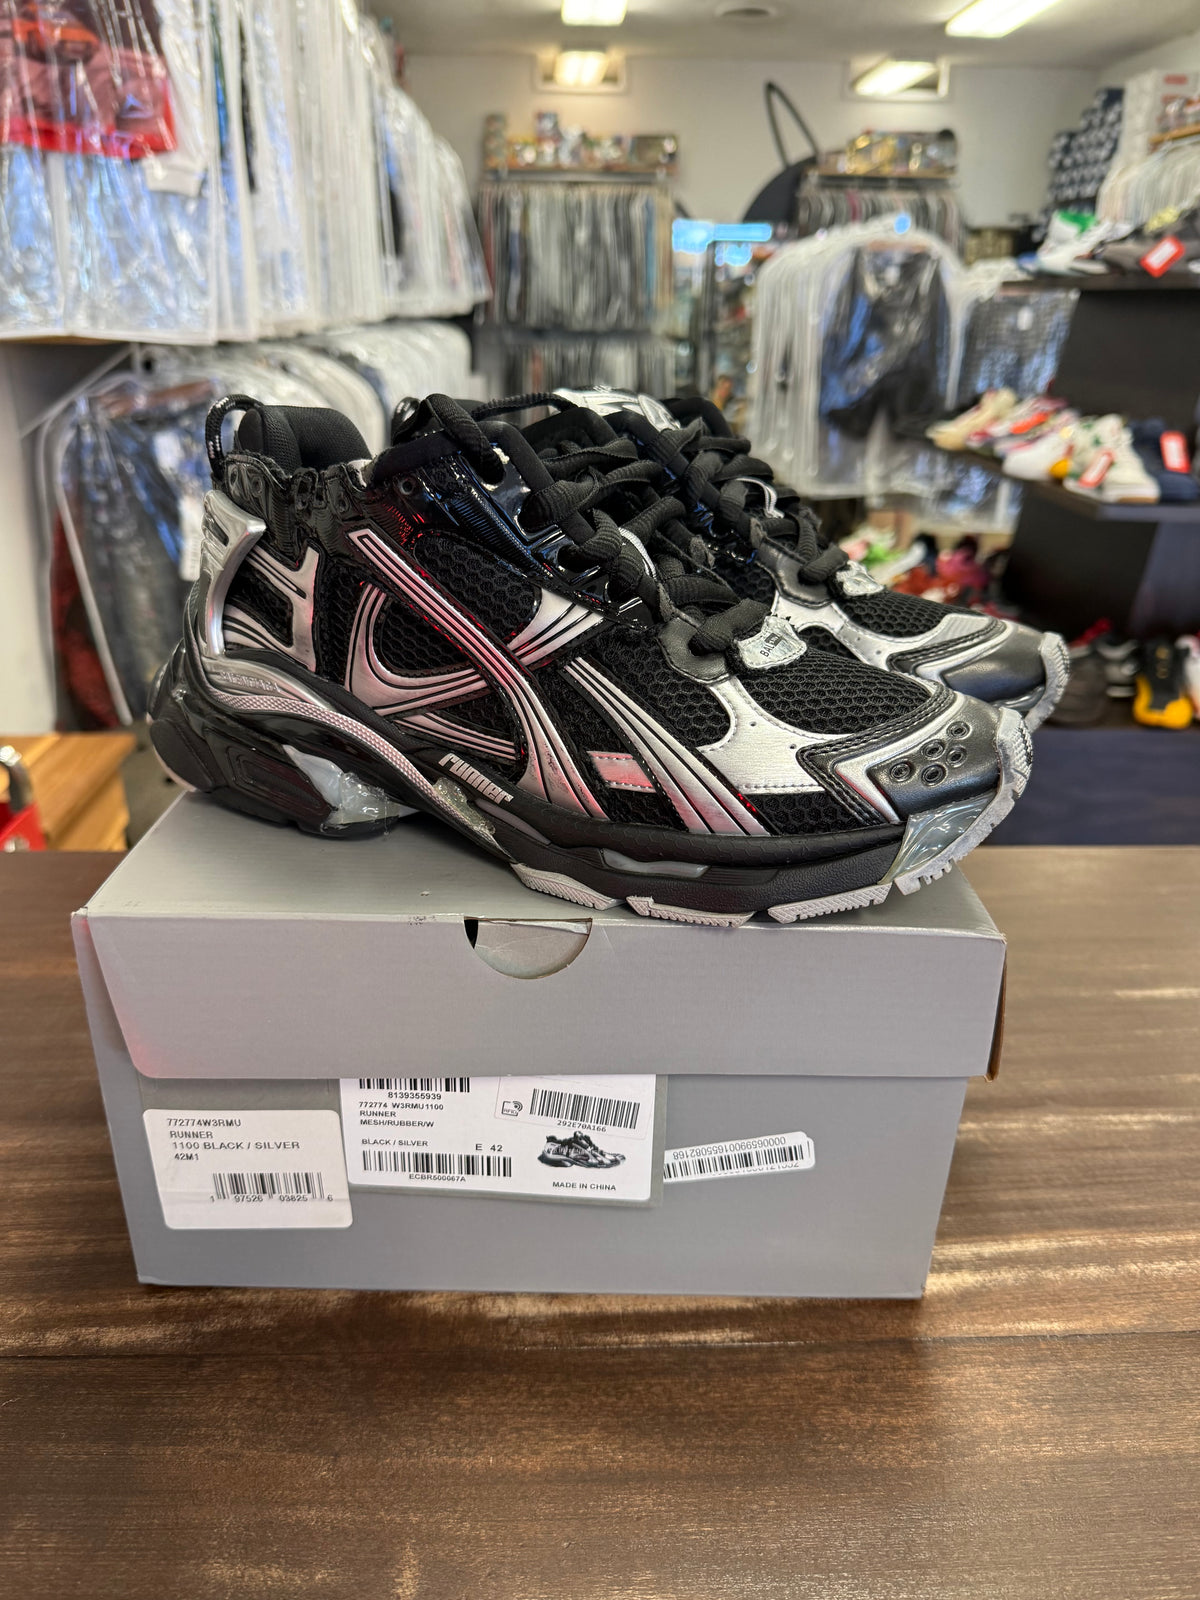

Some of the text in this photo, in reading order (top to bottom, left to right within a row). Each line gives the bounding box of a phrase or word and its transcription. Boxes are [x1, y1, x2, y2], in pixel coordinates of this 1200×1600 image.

[388, 1092, 441, 1100] 8139355939
[392, 1102, 443, 1110] W3RMU1100
[167, 1118, 241, 1127] 772774W3RMU
[360, 1119, 434, 1127] MESH/RUBBER/W
[170, 1131, 213, 1139] RUNNER
[173, 1142, 199, 1150] 1100
[203, 1141, 244, 1149] BLACK
[255, 1141, 300, 1149] SILVER
[361, 1138, 391, 1146] BLACK
[398, 1139, 428, 1147] SILVER
[475, 1143, 503, 1152] E 42
[409, 1173, 466, 1182] ECBR500067A
[552, 1181, 577, 1189] MADE
[590, 1183, 616, 1191] CHINA
[279, 1194, 308, 1202] 03825
[327, 1194, 333, 1202] 6
